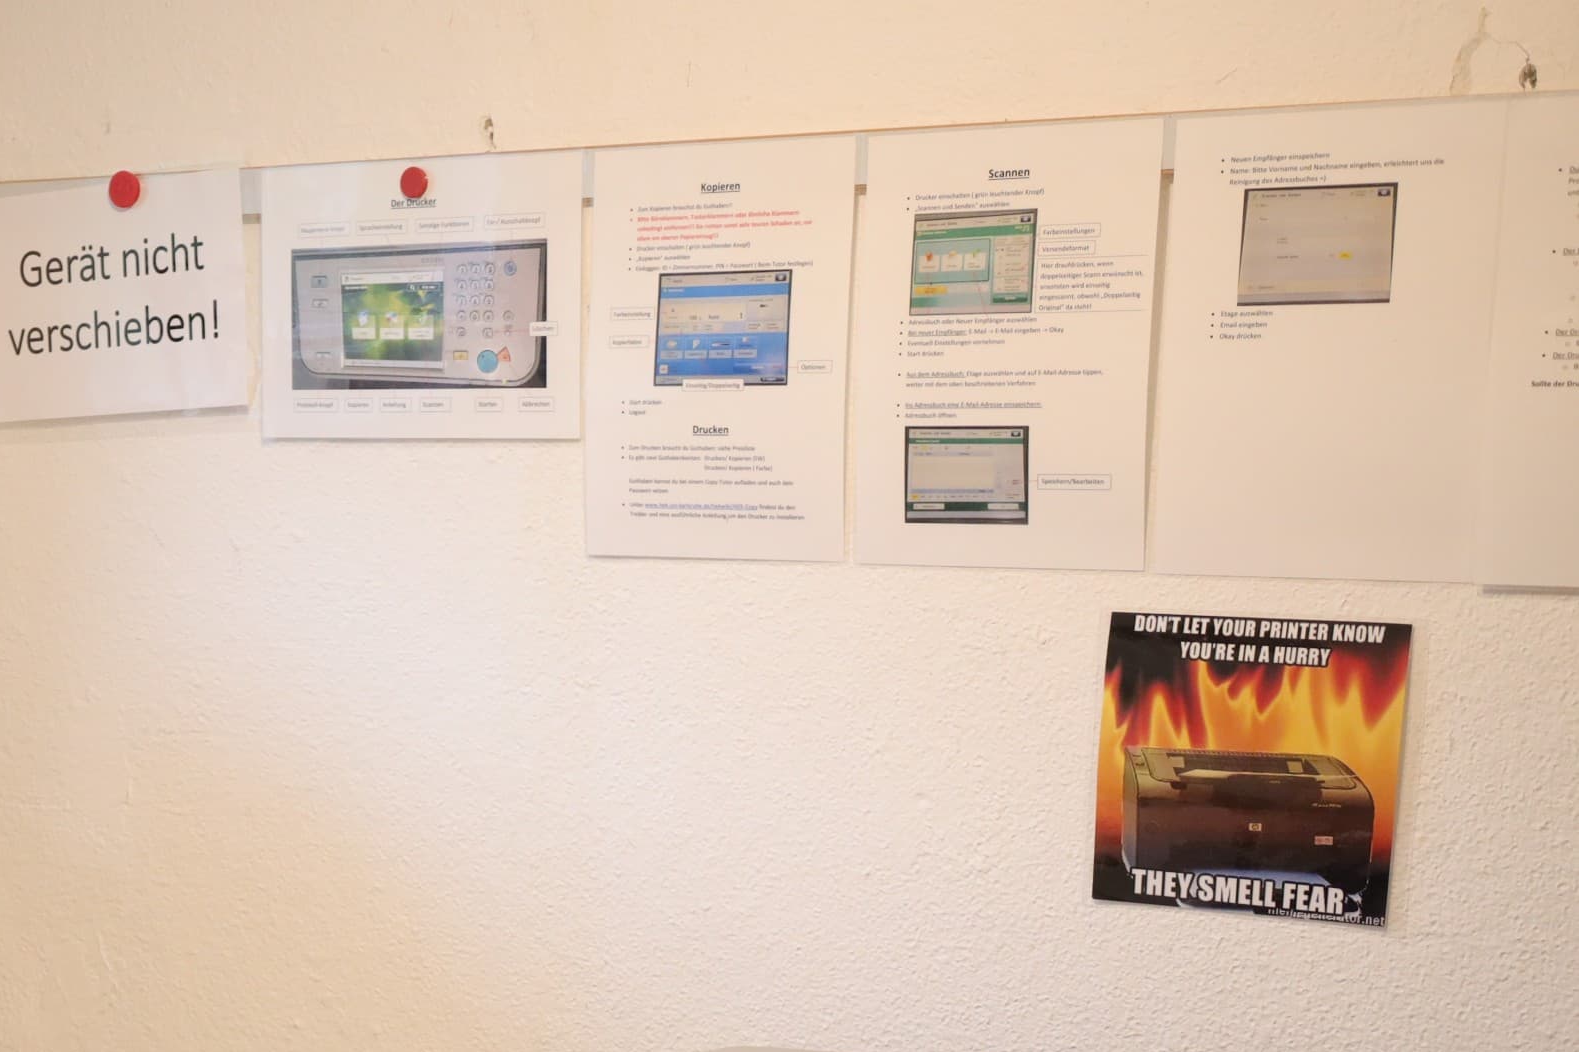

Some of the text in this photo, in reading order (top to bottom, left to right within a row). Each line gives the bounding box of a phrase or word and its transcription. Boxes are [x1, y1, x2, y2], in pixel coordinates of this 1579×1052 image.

[988, 168, 1030, 179] Scannen
[701, 182, 740, 193] Kopieren
[391, 198, 437, 209] Der Drucker
[20, 233, 205, 287] Gerät nicht
[8, 299, 220, 356] verschieben!
[693, 425, 729, 435] Drucken
[1134, 614, 1386, 644] DON'T LET YOUR PRINTER KNOW
[1180, 641, 1331, 667] YOU'RE IN A HURRY
[1130, 868, 1345, 915] THEY SMELL FEAR
